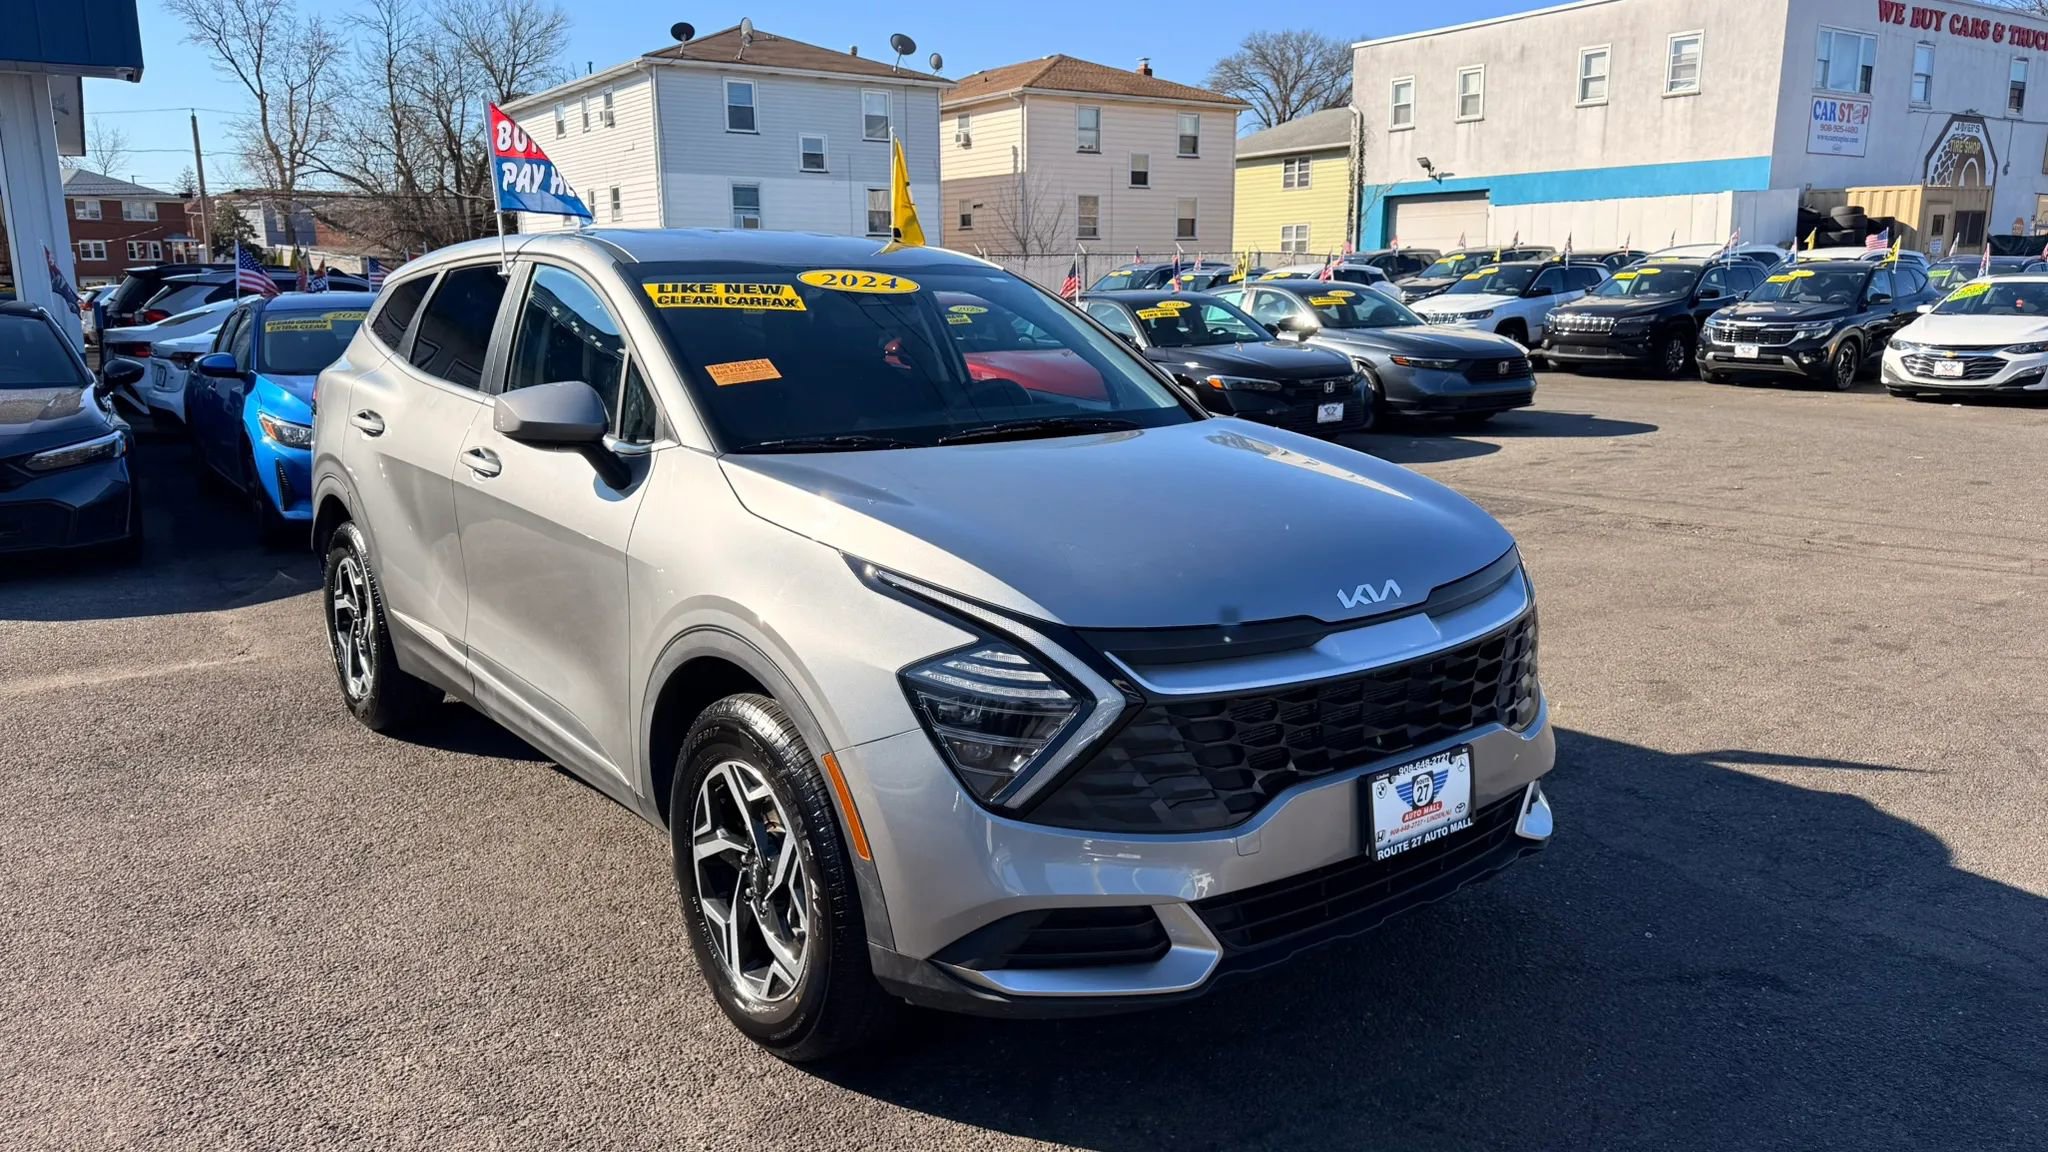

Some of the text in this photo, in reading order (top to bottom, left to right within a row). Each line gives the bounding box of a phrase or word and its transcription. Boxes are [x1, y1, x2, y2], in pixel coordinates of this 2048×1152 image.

[1878, 0, 1906, 24] WE
[1910, 7, 1947, 32] BUY
[1949, 14, 1990, 40] CARS
[1992, 22, 2005, 43] &
[1813, 100, 1837, 122] CAR
[1964, 141, 1981, 154] SHOP
[502, 162, 545, 194] PAY
[657, 284, 784, 295] LIKE NEW
[821, 273, 898, 289] 2024
[657, 295, 799, 308] CLEAN CARFAX
[1337, 579, 1402, 609] KIA
[1398, 752, 1451, 776] 908-648-2727
[1416, 778, 1430, 786] ROUTE
[1416, 784, 1430, 803] 27
[1404, 803, 1441, 822] AUTO MALL
[1377, 817, 1473, 861] ROUTE 27 AUTO MALL
